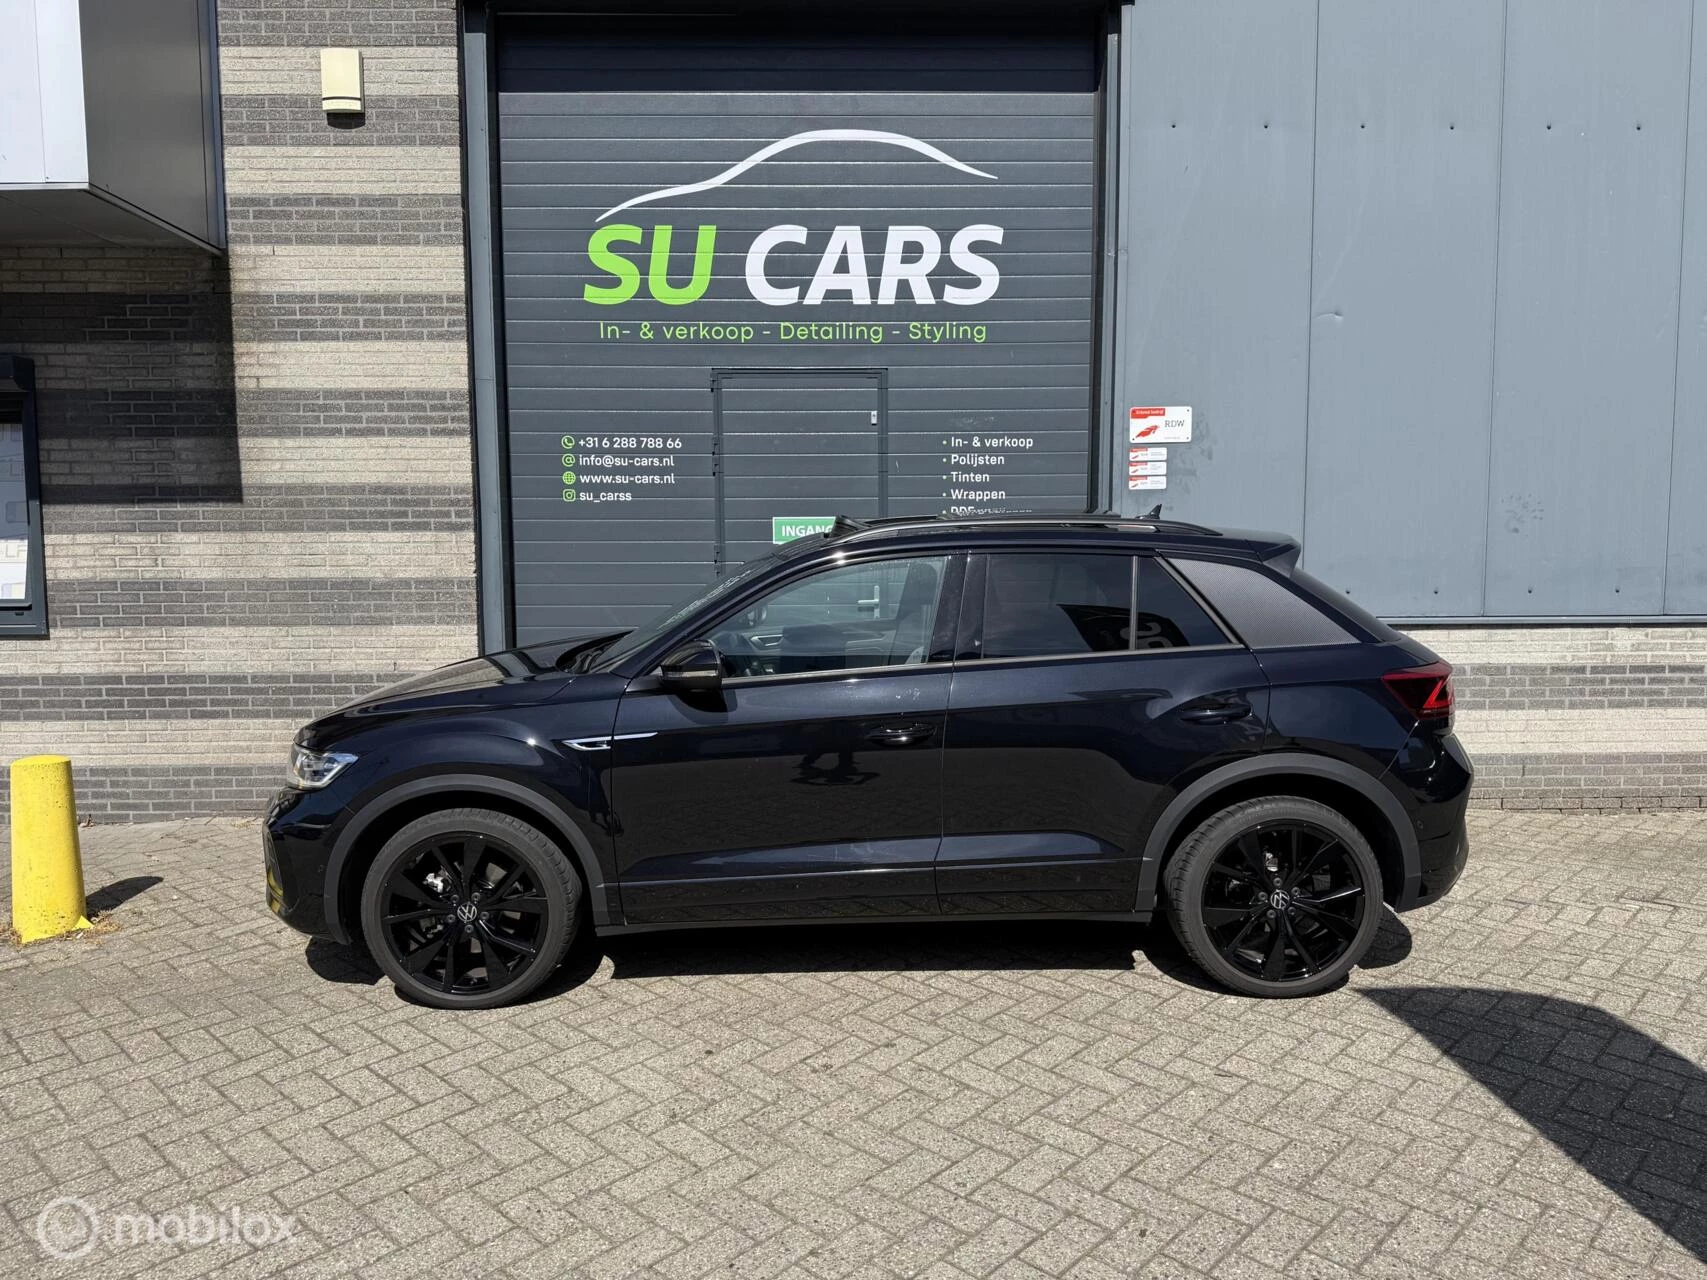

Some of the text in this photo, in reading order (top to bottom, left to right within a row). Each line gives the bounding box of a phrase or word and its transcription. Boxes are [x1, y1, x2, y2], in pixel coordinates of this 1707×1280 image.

[583, 224, 1005, 307] SU CARS
[599, 322, 631, 340] In-
[639, 322, 655, 340] &
[663, 322, 754, 343] verkoop
[779, 322, 884, 344] Detailing
[908, 321, 987, 343] Styling
[1164, 419, 1185, 428] RDW
[578, 437, 683, 449] +31 6 288 788 66
[951, 435, 1034, 450] In- & verkoop
[579, 454, 675, 468] info@su-cars.nl
[951, 453, 1005, 468] Polijsten
[580, 473, 676, 484] www.su-cars.nl
[950, 471, 990, 483] Tinten
[579, 491, 633, 503] su_carss
[950, 488, 1006, 502] Wrappen
